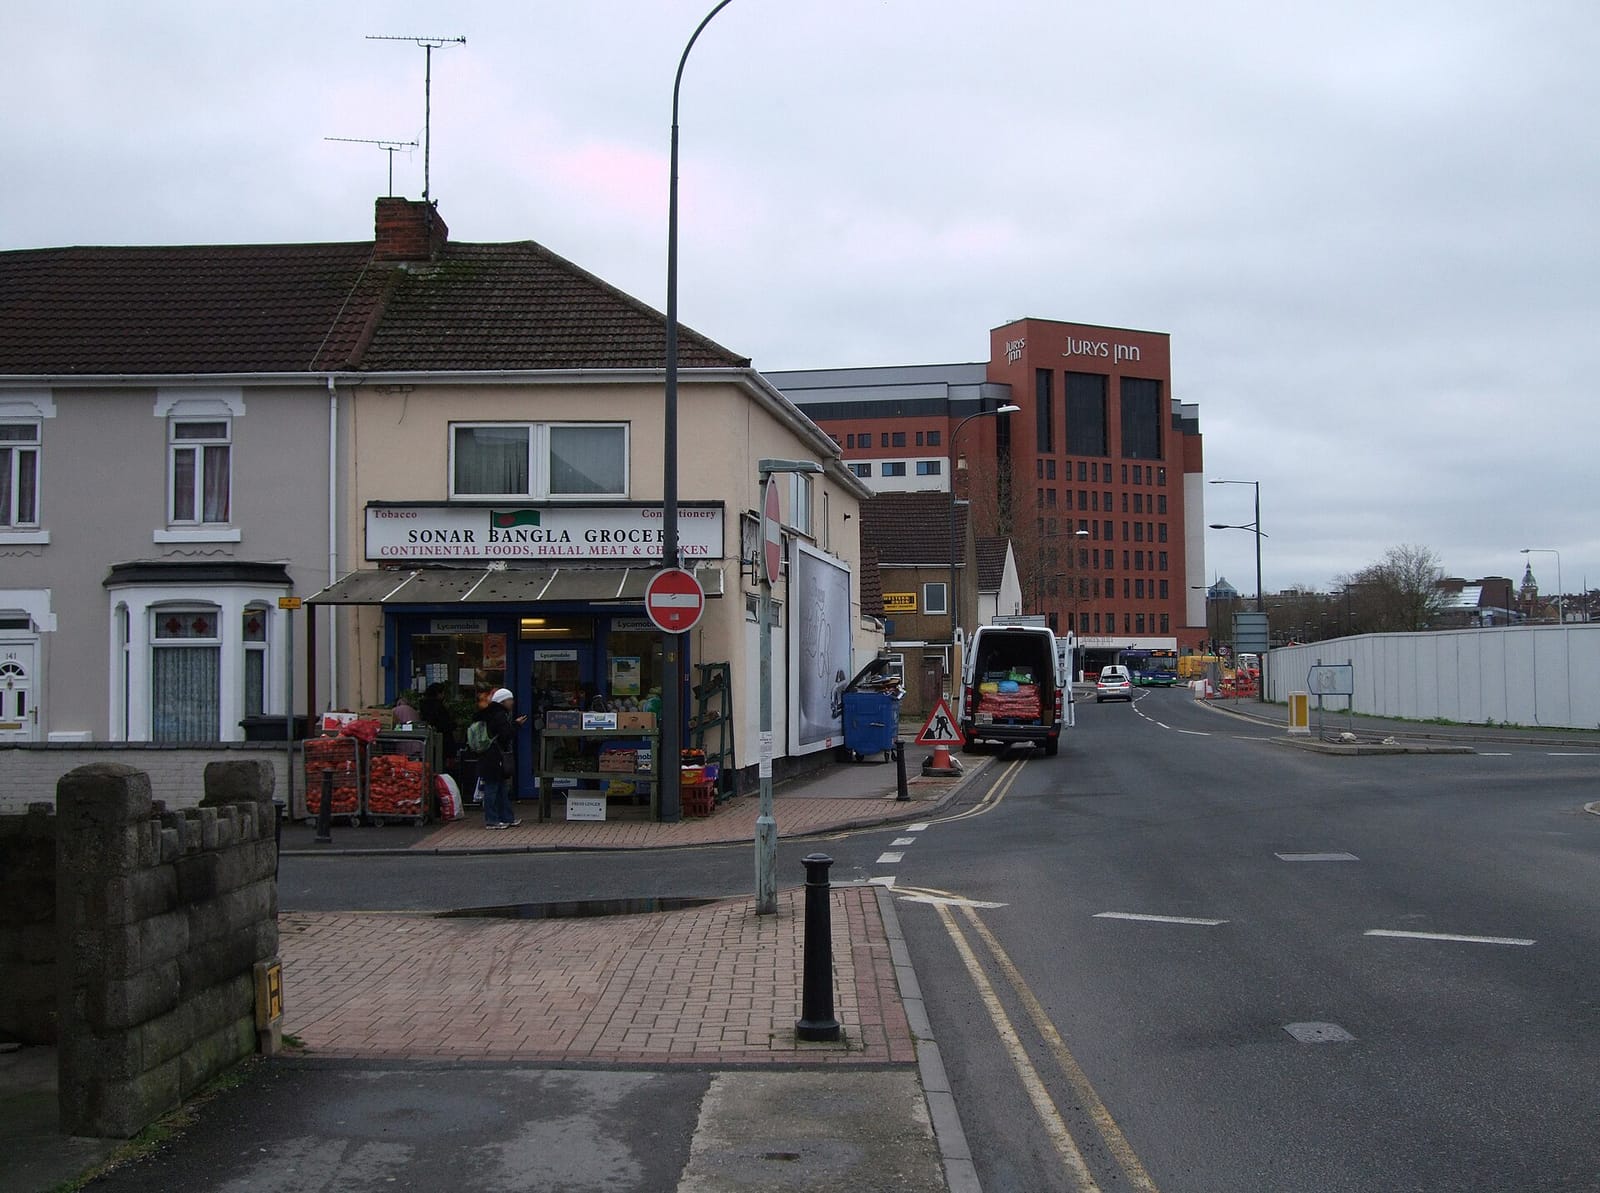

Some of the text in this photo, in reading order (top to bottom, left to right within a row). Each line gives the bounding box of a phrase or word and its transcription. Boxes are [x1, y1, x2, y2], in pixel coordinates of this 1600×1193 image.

[1062, 336, 1109, 357] JURYS
[374, 510, 417, 519] Tobacco
[642, 509, 716, 520] Contionery
[408, 529, 475, 543] SONAR
[489, 529, 571, 543] BANGLA
[381, 545, 708, 557] CONTINENTAL FOODS, HALAL MEAT & CHKEN
